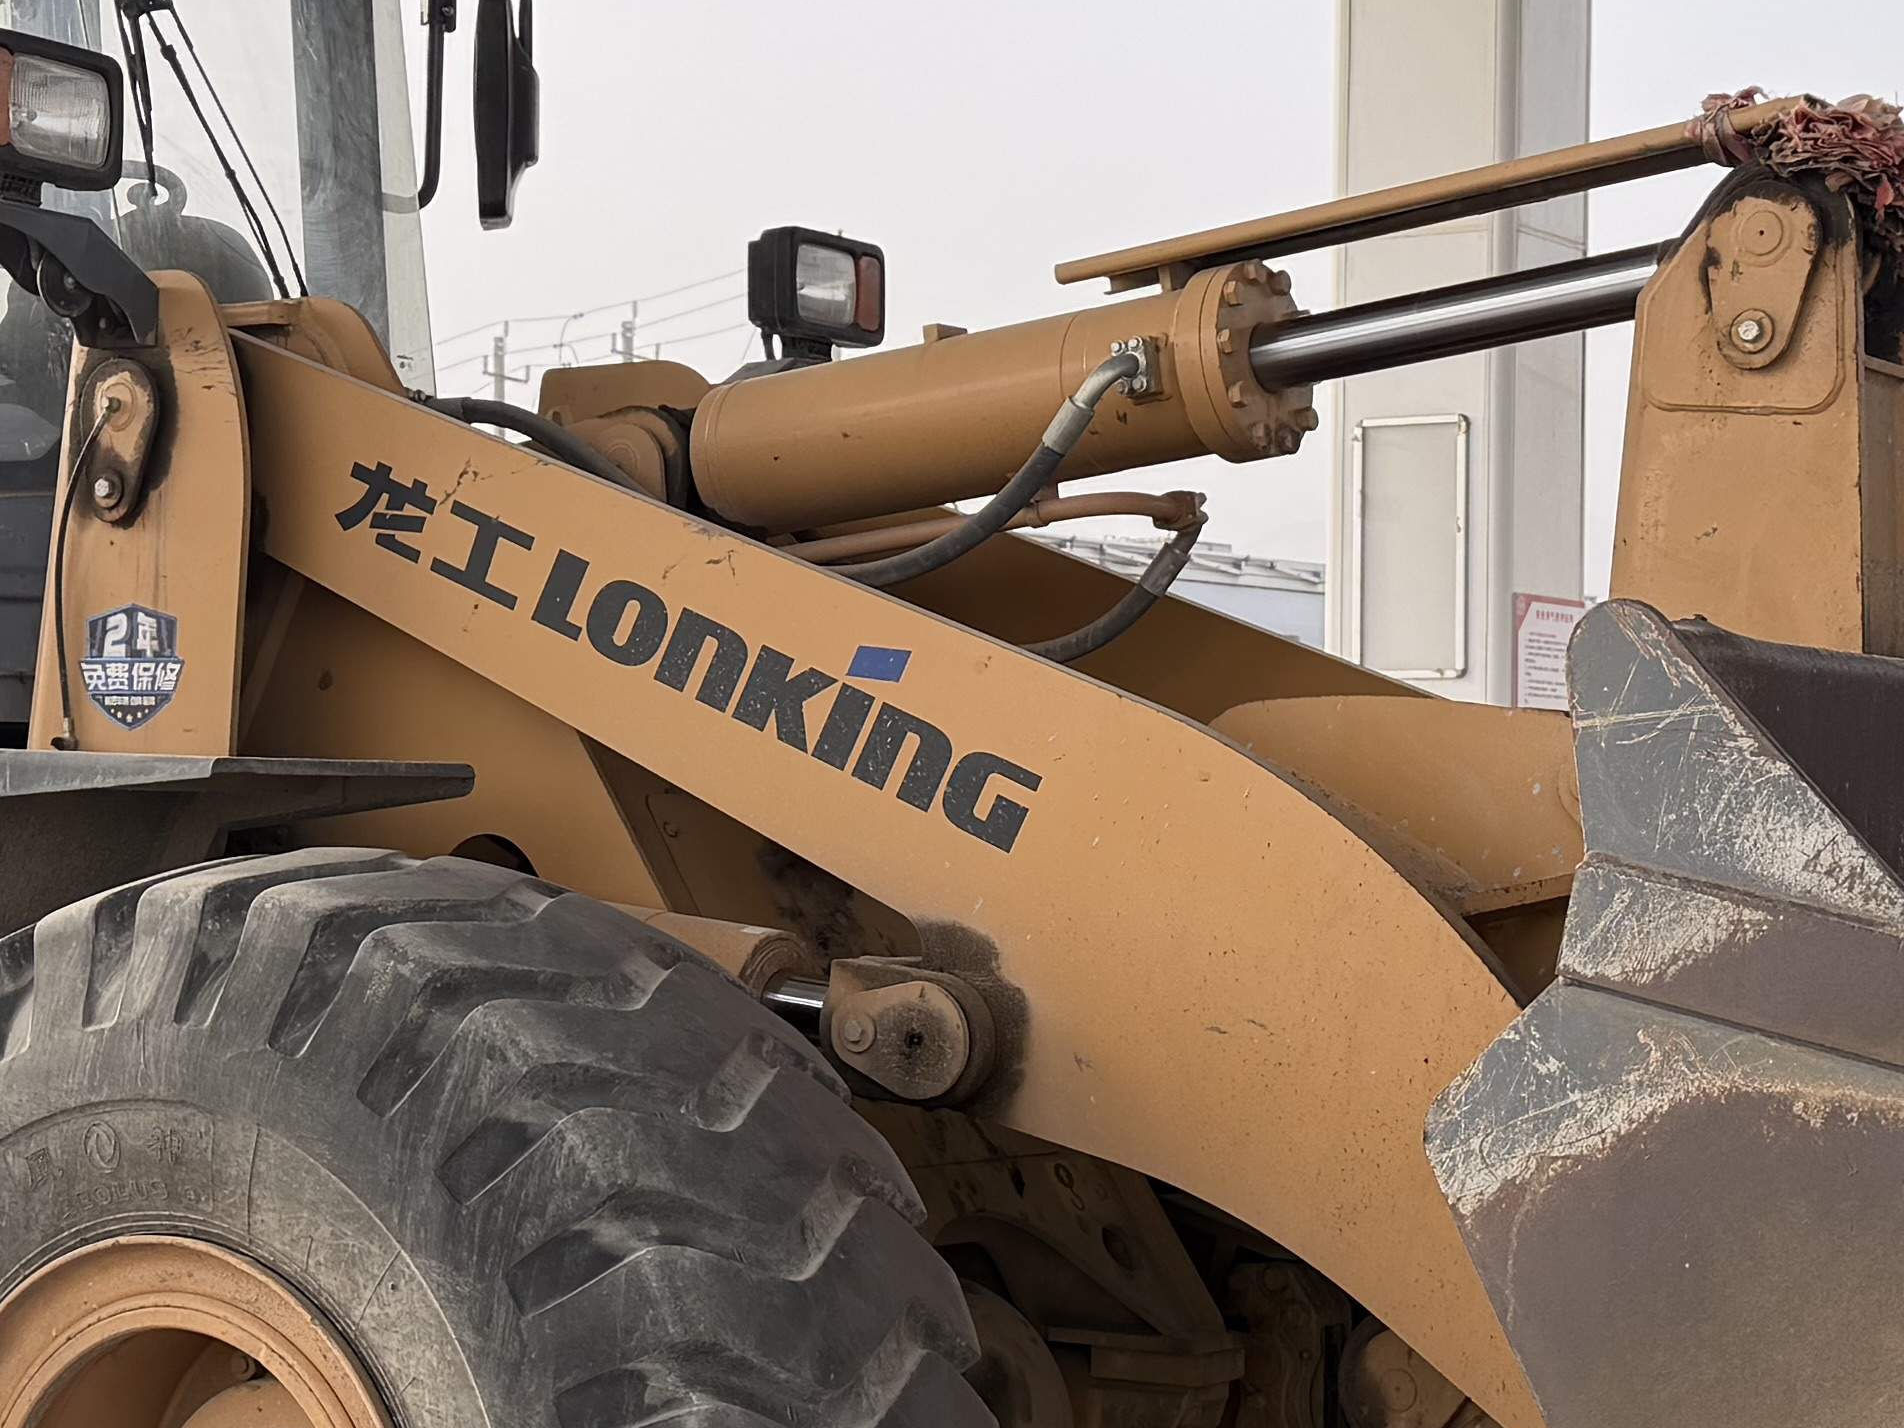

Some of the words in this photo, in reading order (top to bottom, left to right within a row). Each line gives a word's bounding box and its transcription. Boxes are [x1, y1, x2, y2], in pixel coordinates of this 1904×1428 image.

[80, 661, 182, 692] 免费保修
[334, 460, 536, 611] 龙工
[530, 548, 1044, 854] LONKING
